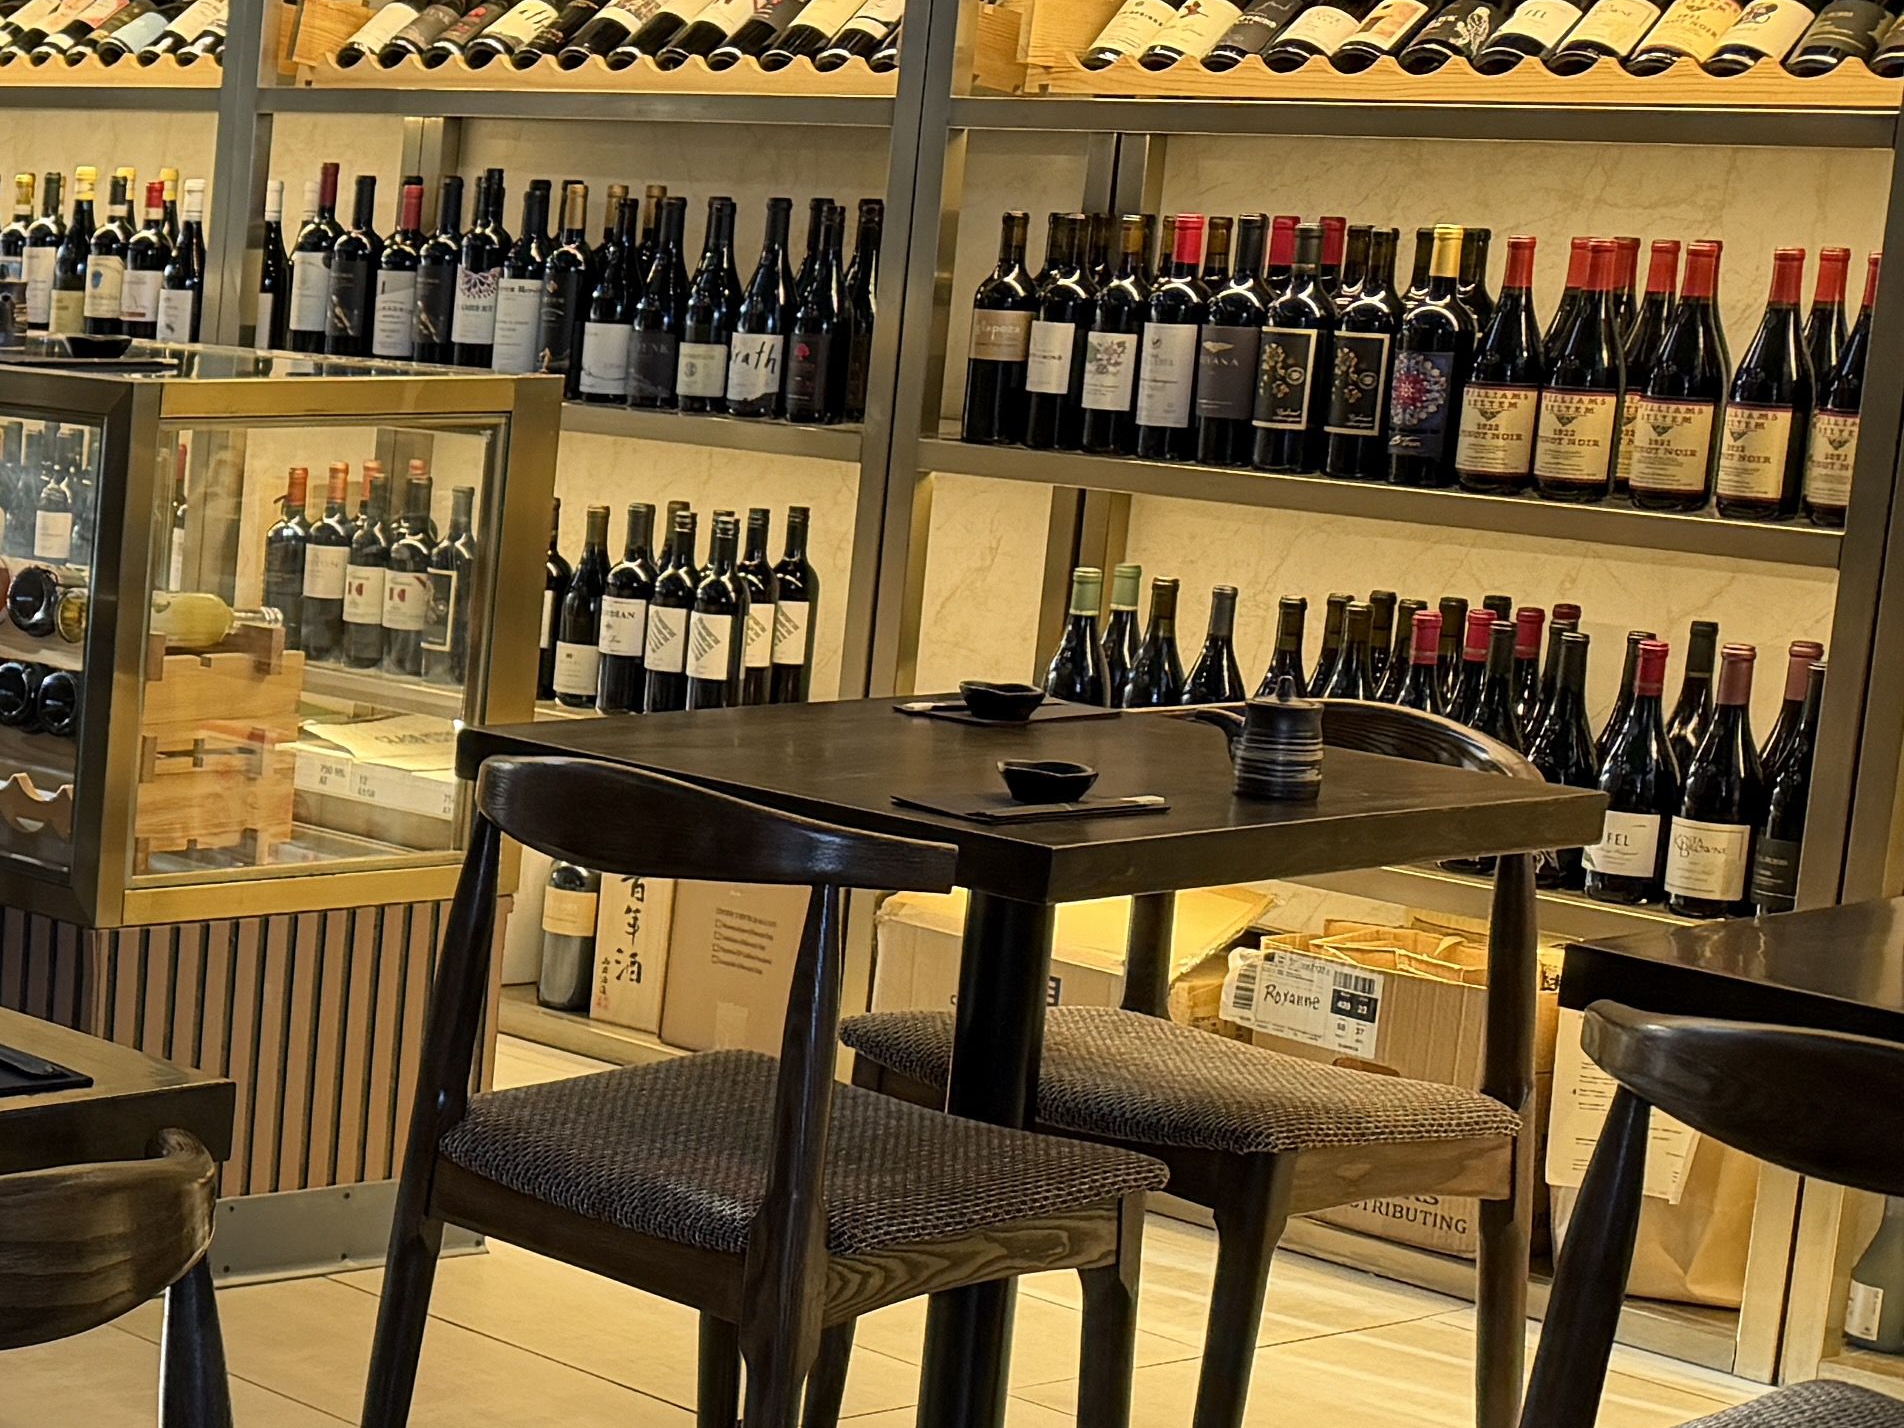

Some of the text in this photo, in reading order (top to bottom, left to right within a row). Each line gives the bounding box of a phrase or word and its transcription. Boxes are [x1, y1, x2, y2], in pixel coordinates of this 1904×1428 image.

[732, 340, 776, 373] rath
[1606, 832, 1630, 847] FEL
[1350, 1198, 1468, 1235] TRIBUTING
